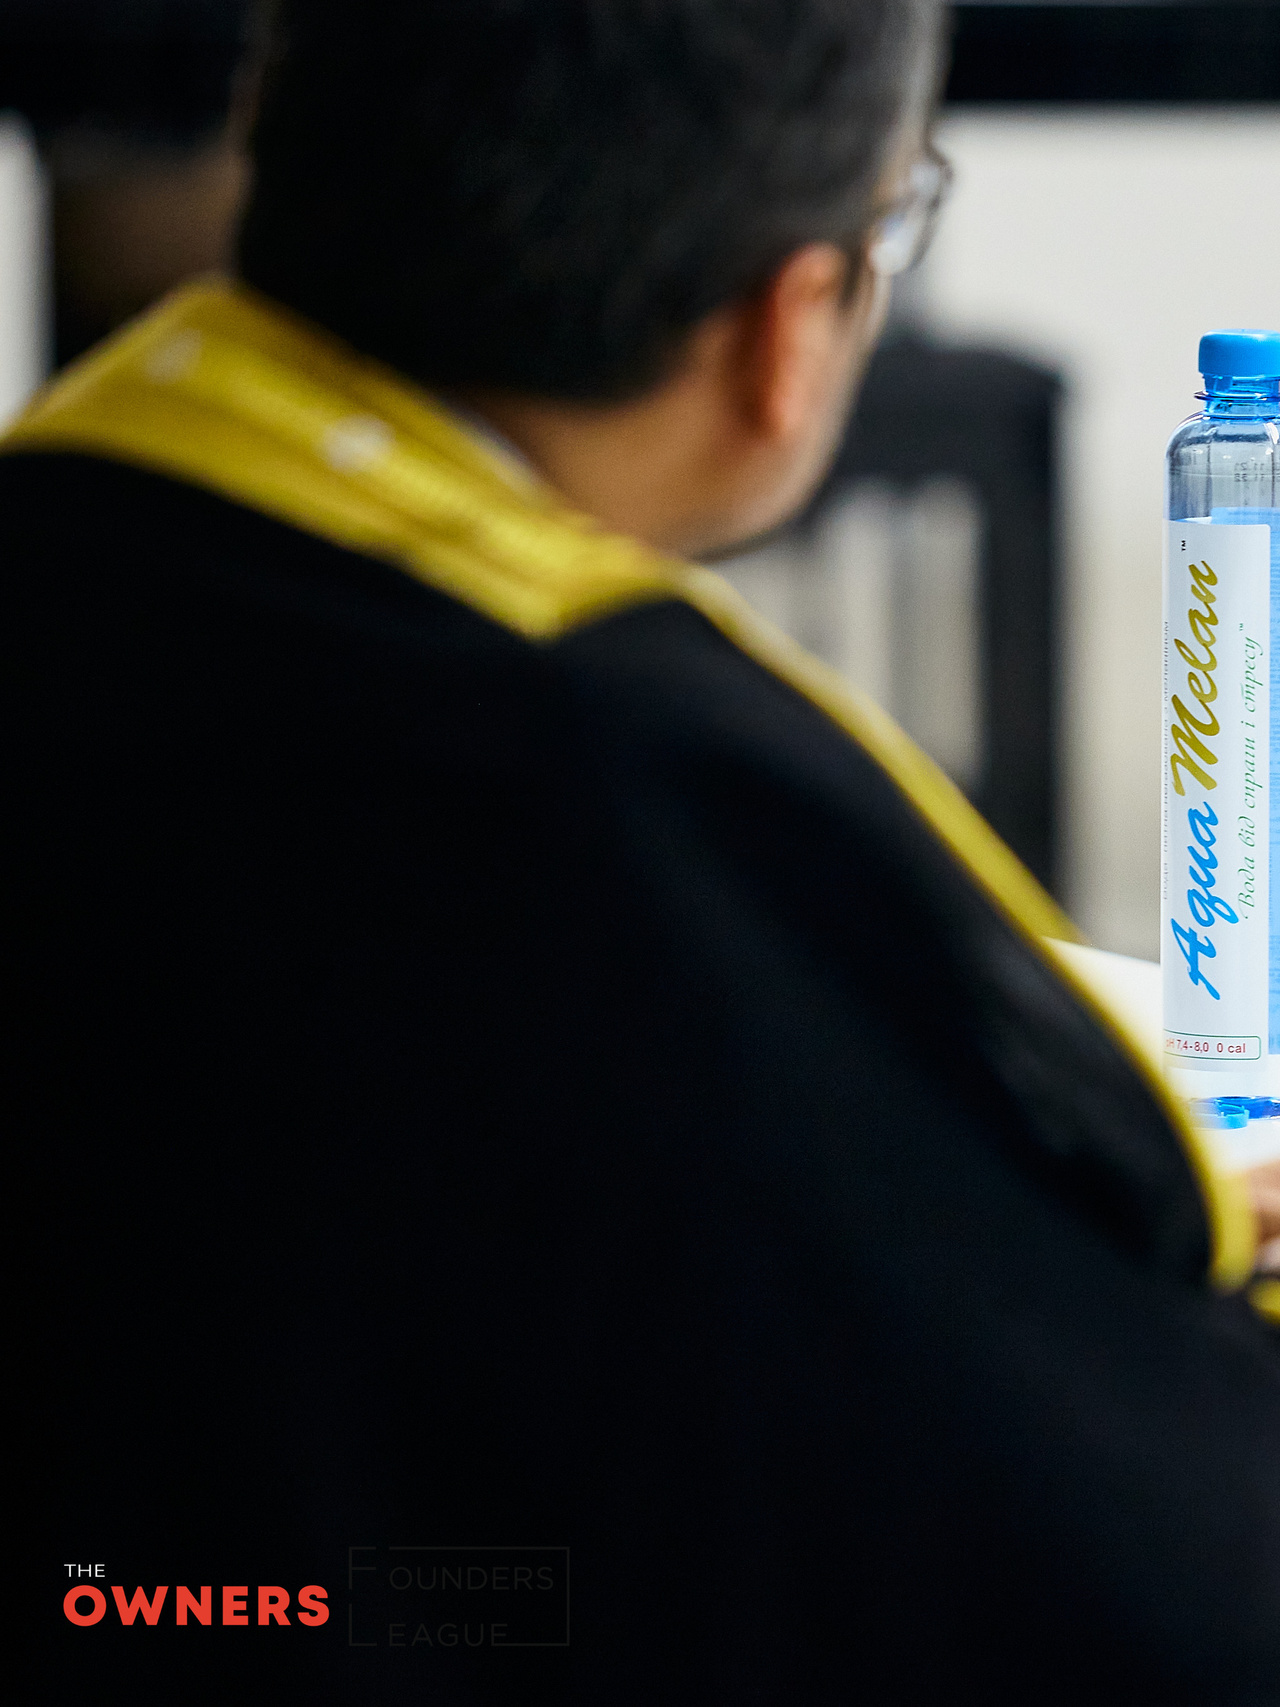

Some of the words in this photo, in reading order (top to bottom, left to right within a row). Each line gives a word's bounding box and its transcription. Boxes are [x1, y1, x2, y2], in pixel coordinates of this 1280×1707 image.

[1170, 560, 1219, 796] Melan
[1244, 737, 1263, 809] спраги
[1238, 816, 1255, 847] від
[1171, 801, 1239, 1000] Aqua
[1238, 856, 1255, 919] Вода
[1227, 1043, 1246, 1053] cal
